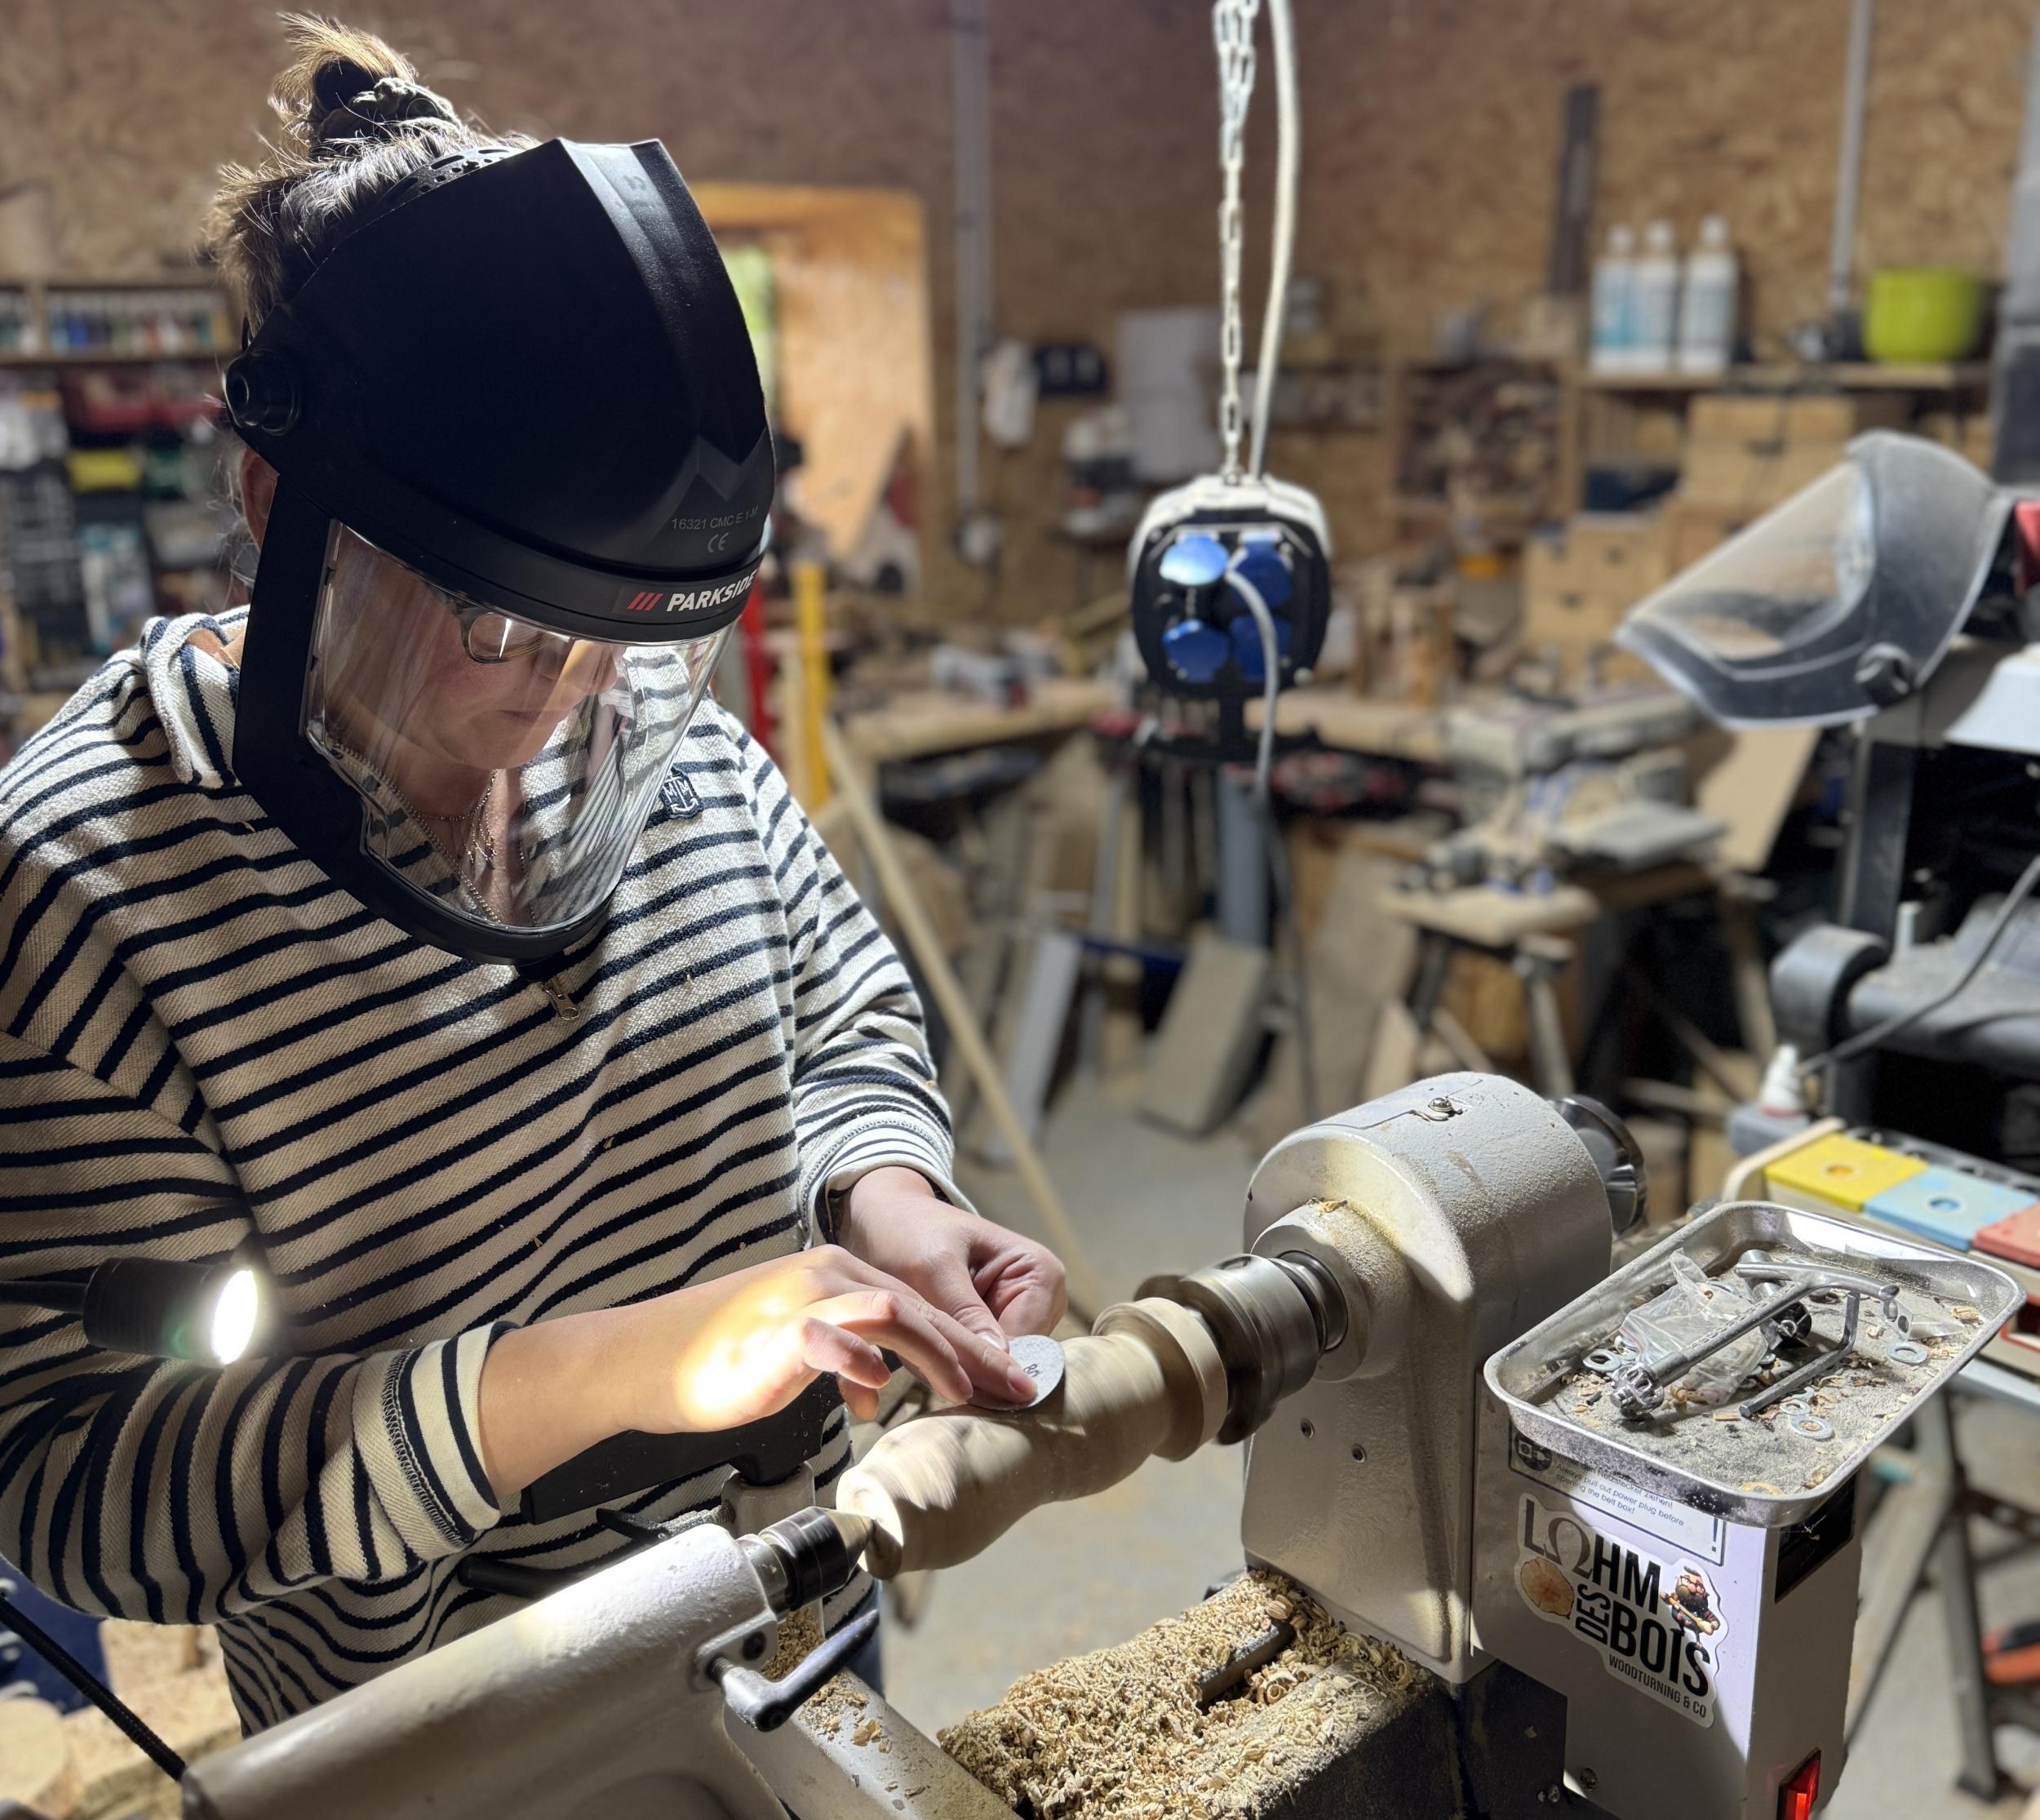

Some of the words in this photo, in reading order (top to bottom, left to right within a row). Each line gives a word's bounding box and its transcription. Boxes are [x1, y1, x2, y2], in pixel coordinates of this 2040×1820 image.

[672, 517, 707, 530] 16321
[667, 569, 758, 612] PARKSIDE
[1556, 1474, 1586, 1493] opening
[1588, 1487, 1600, 1498] the
[1601, 1494, 1616, 1506] belt
[1556, 1463, 1582, 1481] Always
[1583, 1476, 1599, 1487] pull
[1599, 1484, 1612, 1494] out
[1613, 1489, 1637, 1505] power
[1638, 1501, 1656, 1516] plug
[1658, 1509, 1684, 1526] before
[1575, 1583, 1611, 1645] DES
[1610, 1600, 1711, 1698] BOIS
[1608, 1654, 1681, 1704] WOODTURNING
[1683, 1695, 1691, 1709] &
[1692, 1700, 1707, 1719] CO
